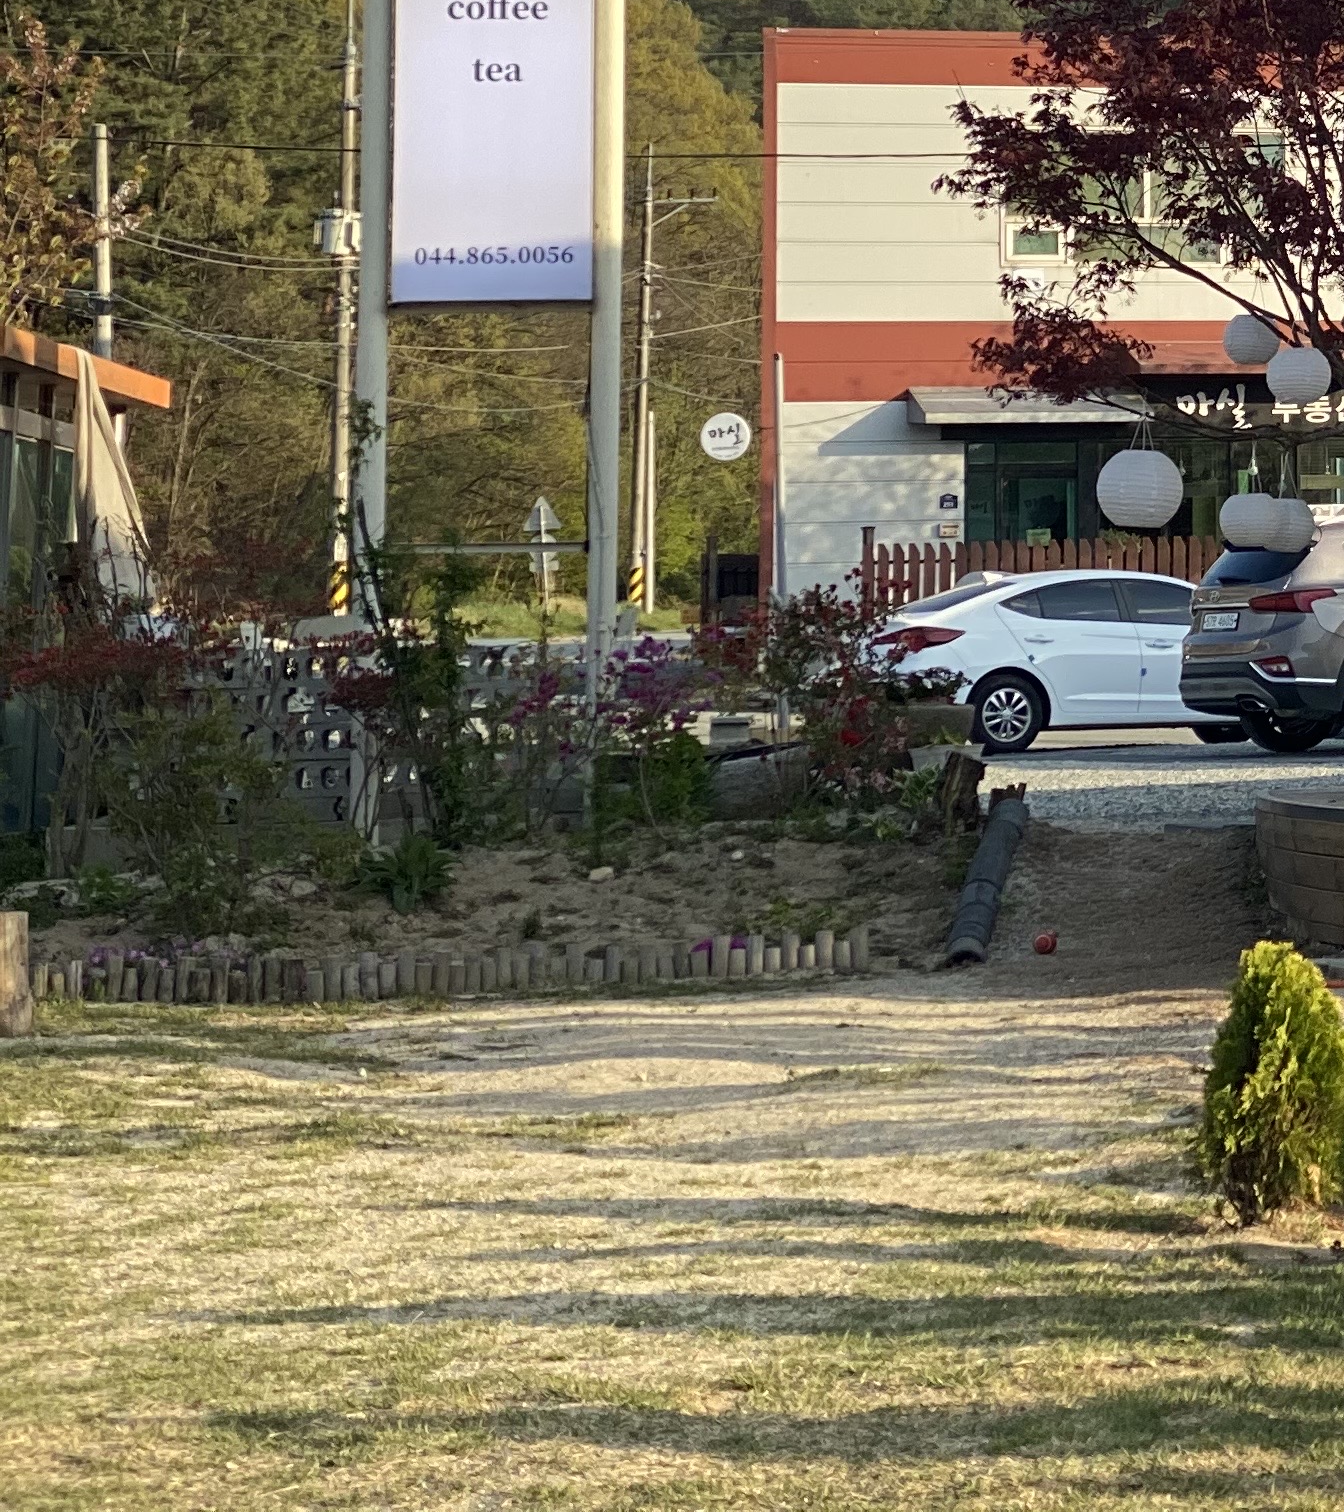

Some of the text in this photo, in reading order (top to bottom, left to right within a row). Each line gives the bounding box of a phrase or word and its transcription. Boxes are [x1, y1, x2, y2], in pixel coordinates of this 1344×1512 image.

[472, 58, 522, 82] tea
[414, 246, 573, 265] 044.865.0056
[1176, 384, 1252, 429] 마실
[707, 422, 743, 445] 마실
